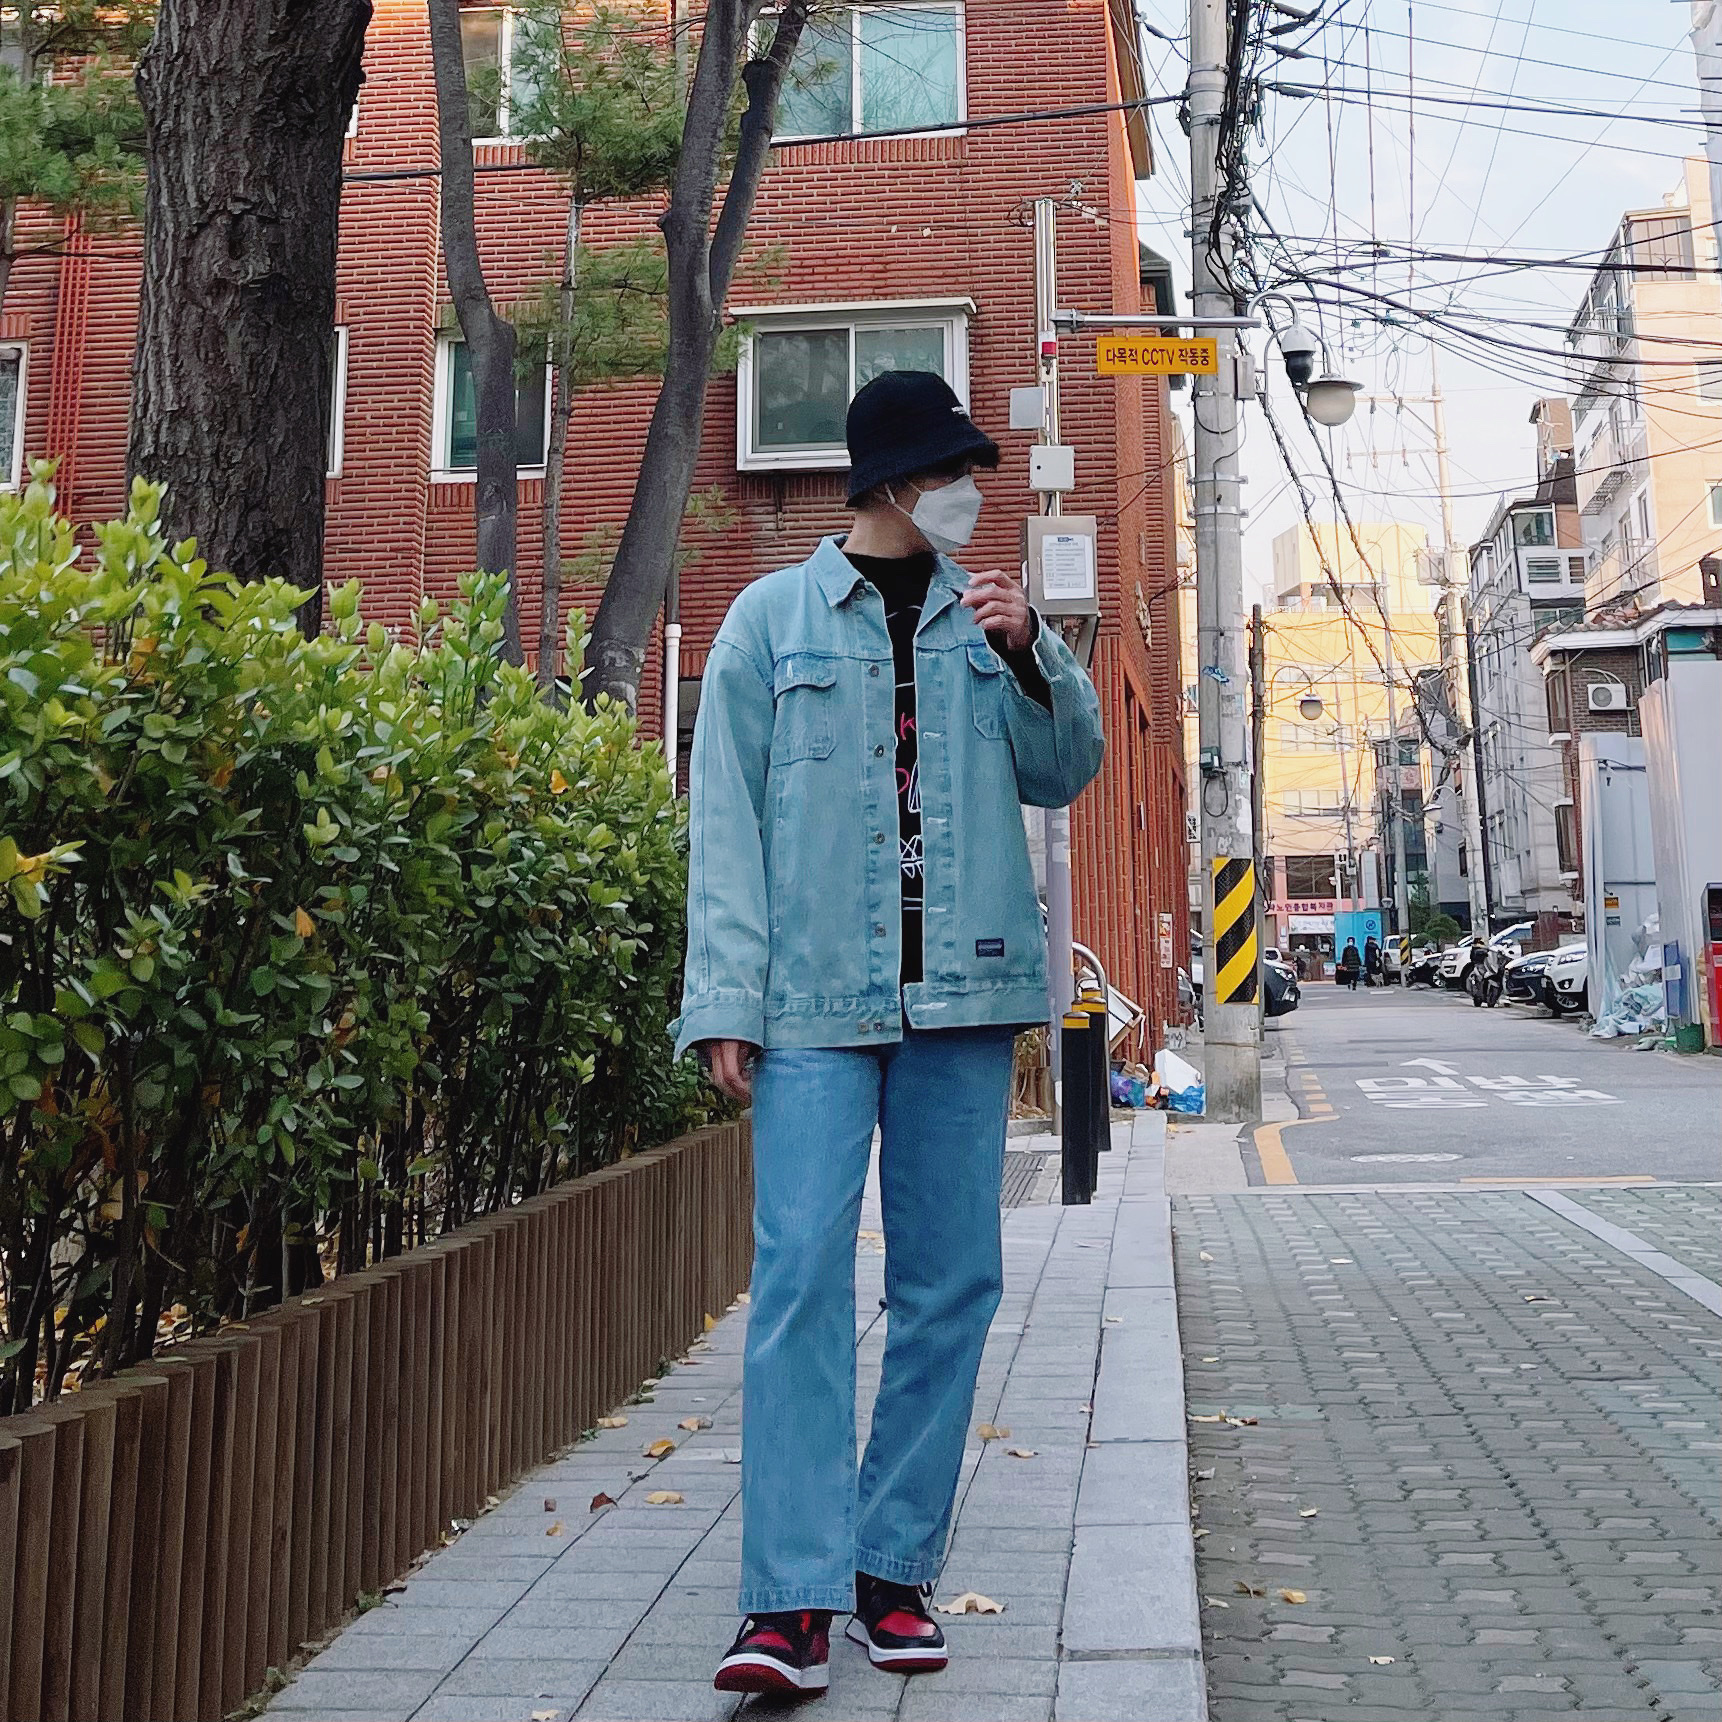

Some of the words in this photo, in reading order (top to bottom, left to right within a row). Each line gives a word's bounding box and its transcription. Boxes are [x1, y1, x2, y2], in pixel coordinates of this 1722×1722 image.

[1106, 347, 1138, 365] 다목적
[1141, 347, 1175, 365] CCTV
[1178, 347, 1210, 366] 작동중
